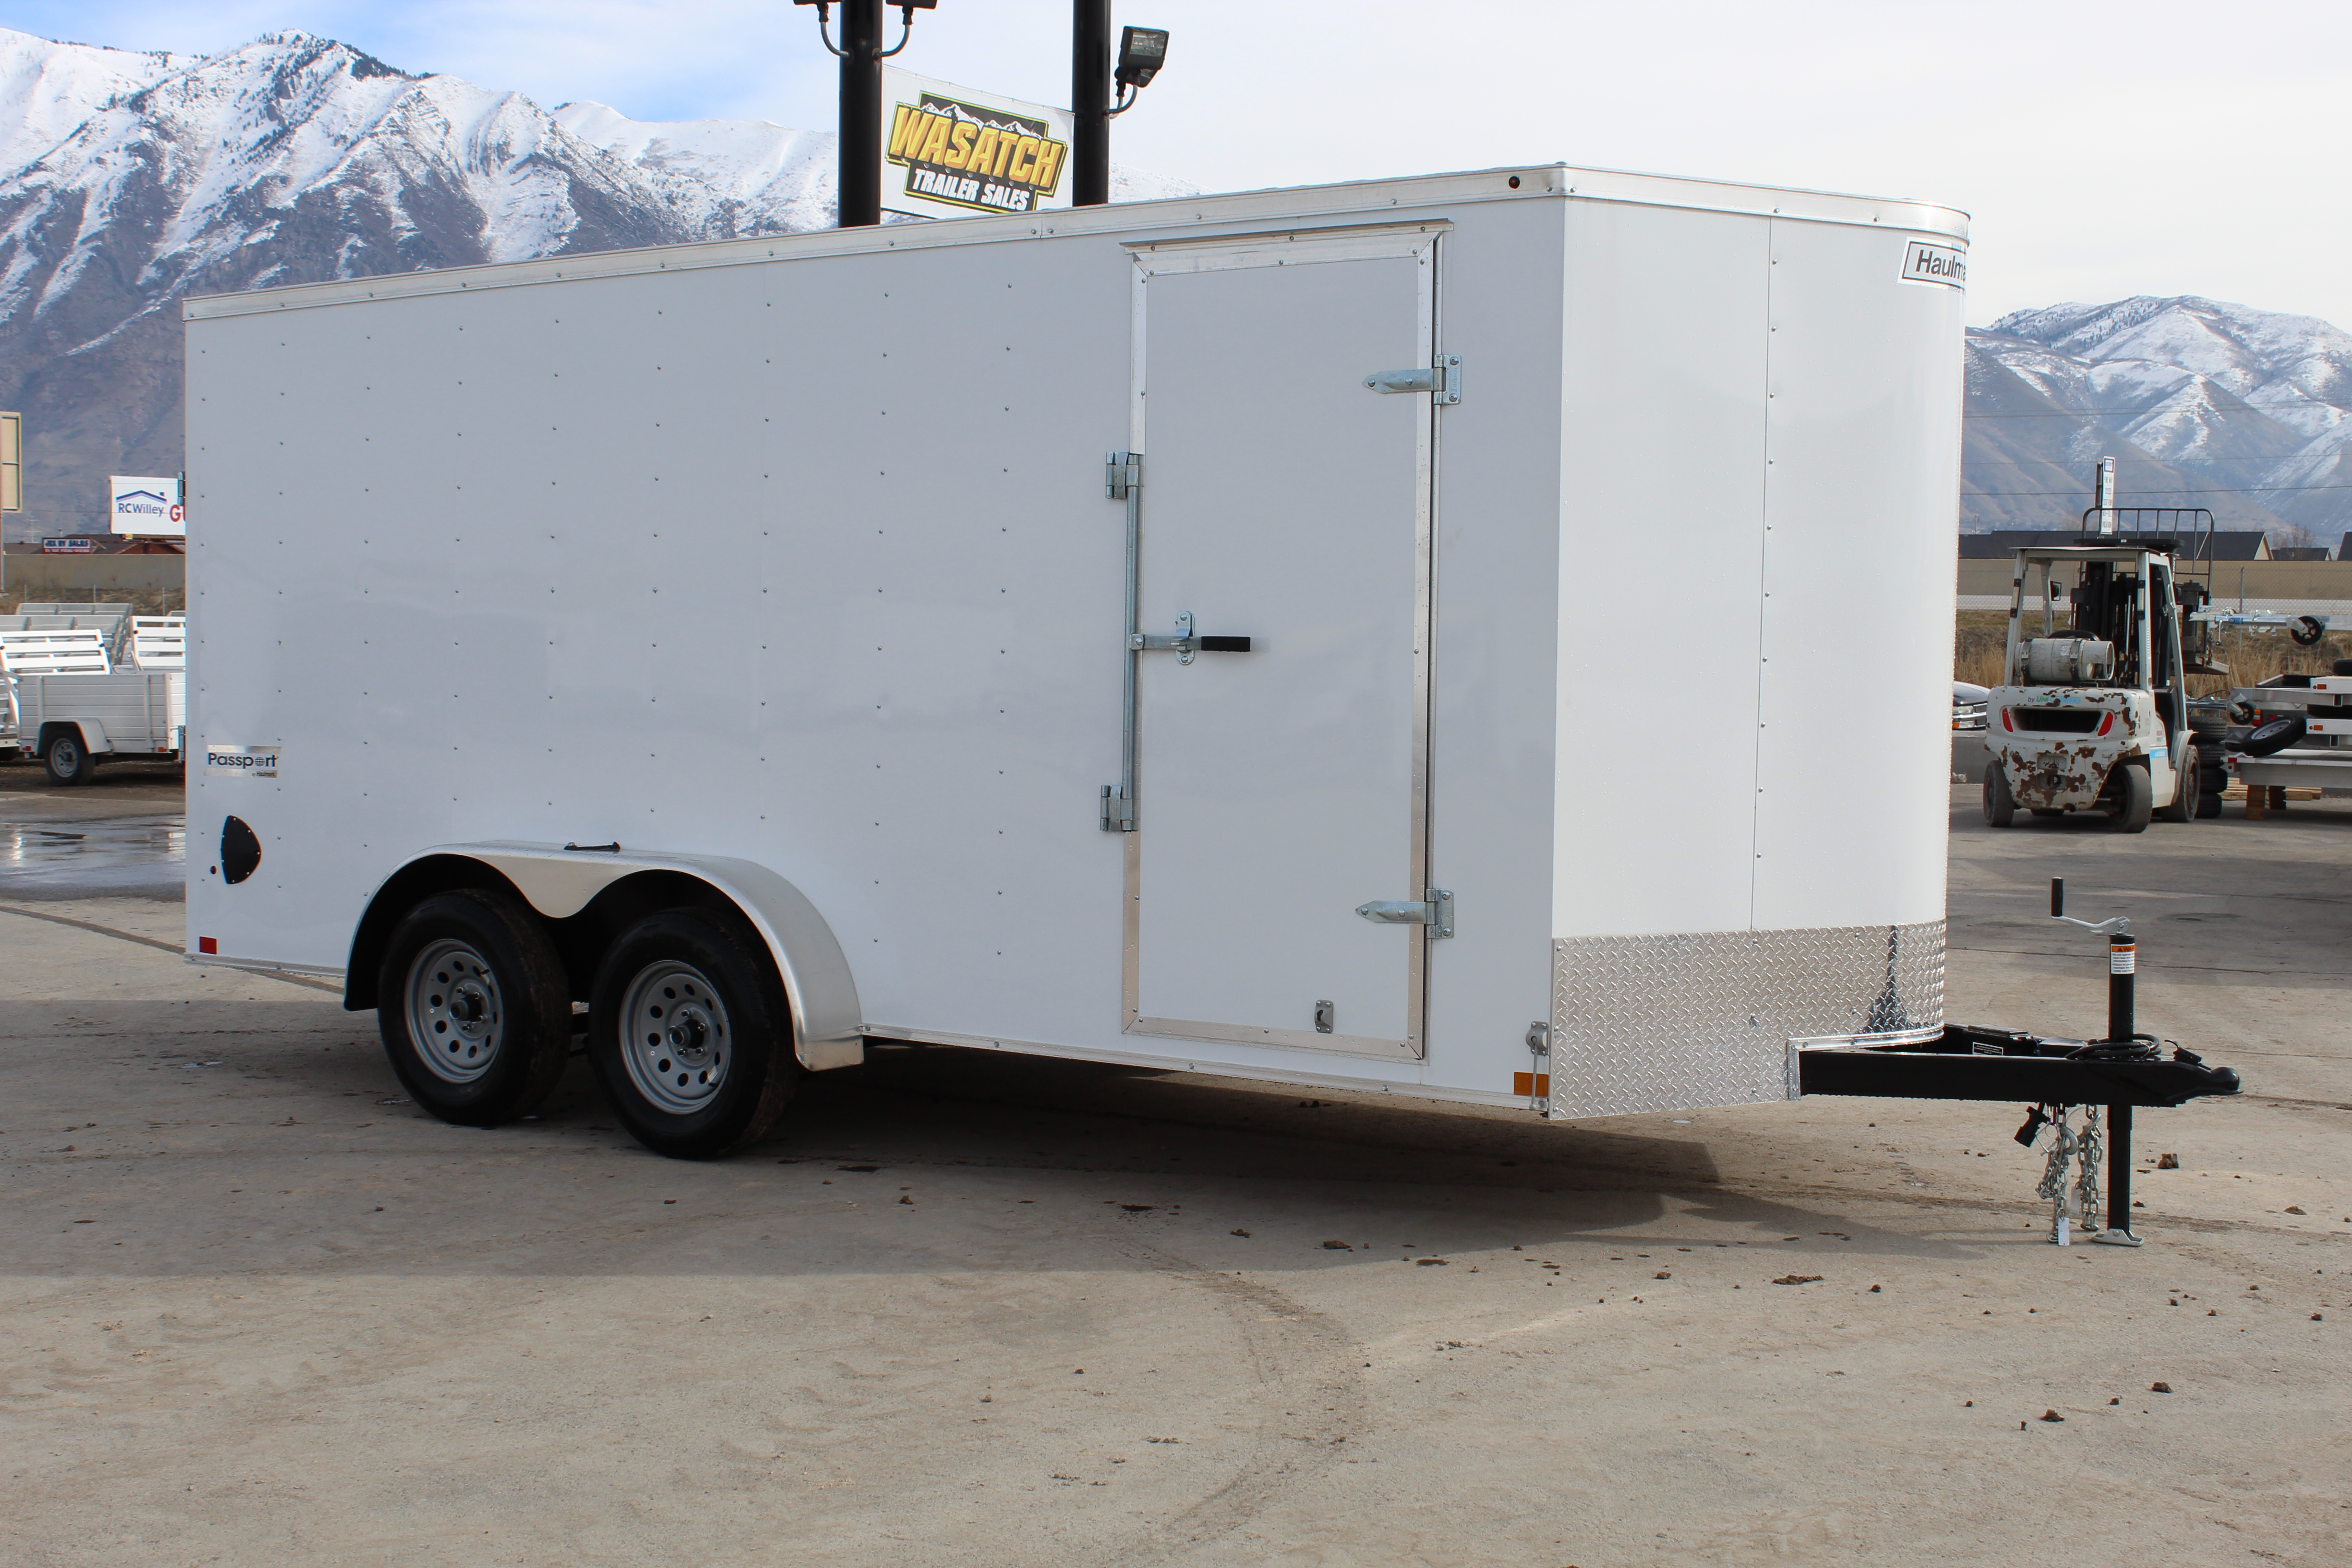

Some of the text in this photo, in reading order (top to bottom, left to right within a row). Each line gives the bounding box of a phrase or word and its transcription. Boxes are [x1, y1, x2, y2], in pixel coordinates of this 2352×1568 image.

[889, 106, 1061, 189] WASATCH
[912, 168, 1029, 211] TRAILER SALES
